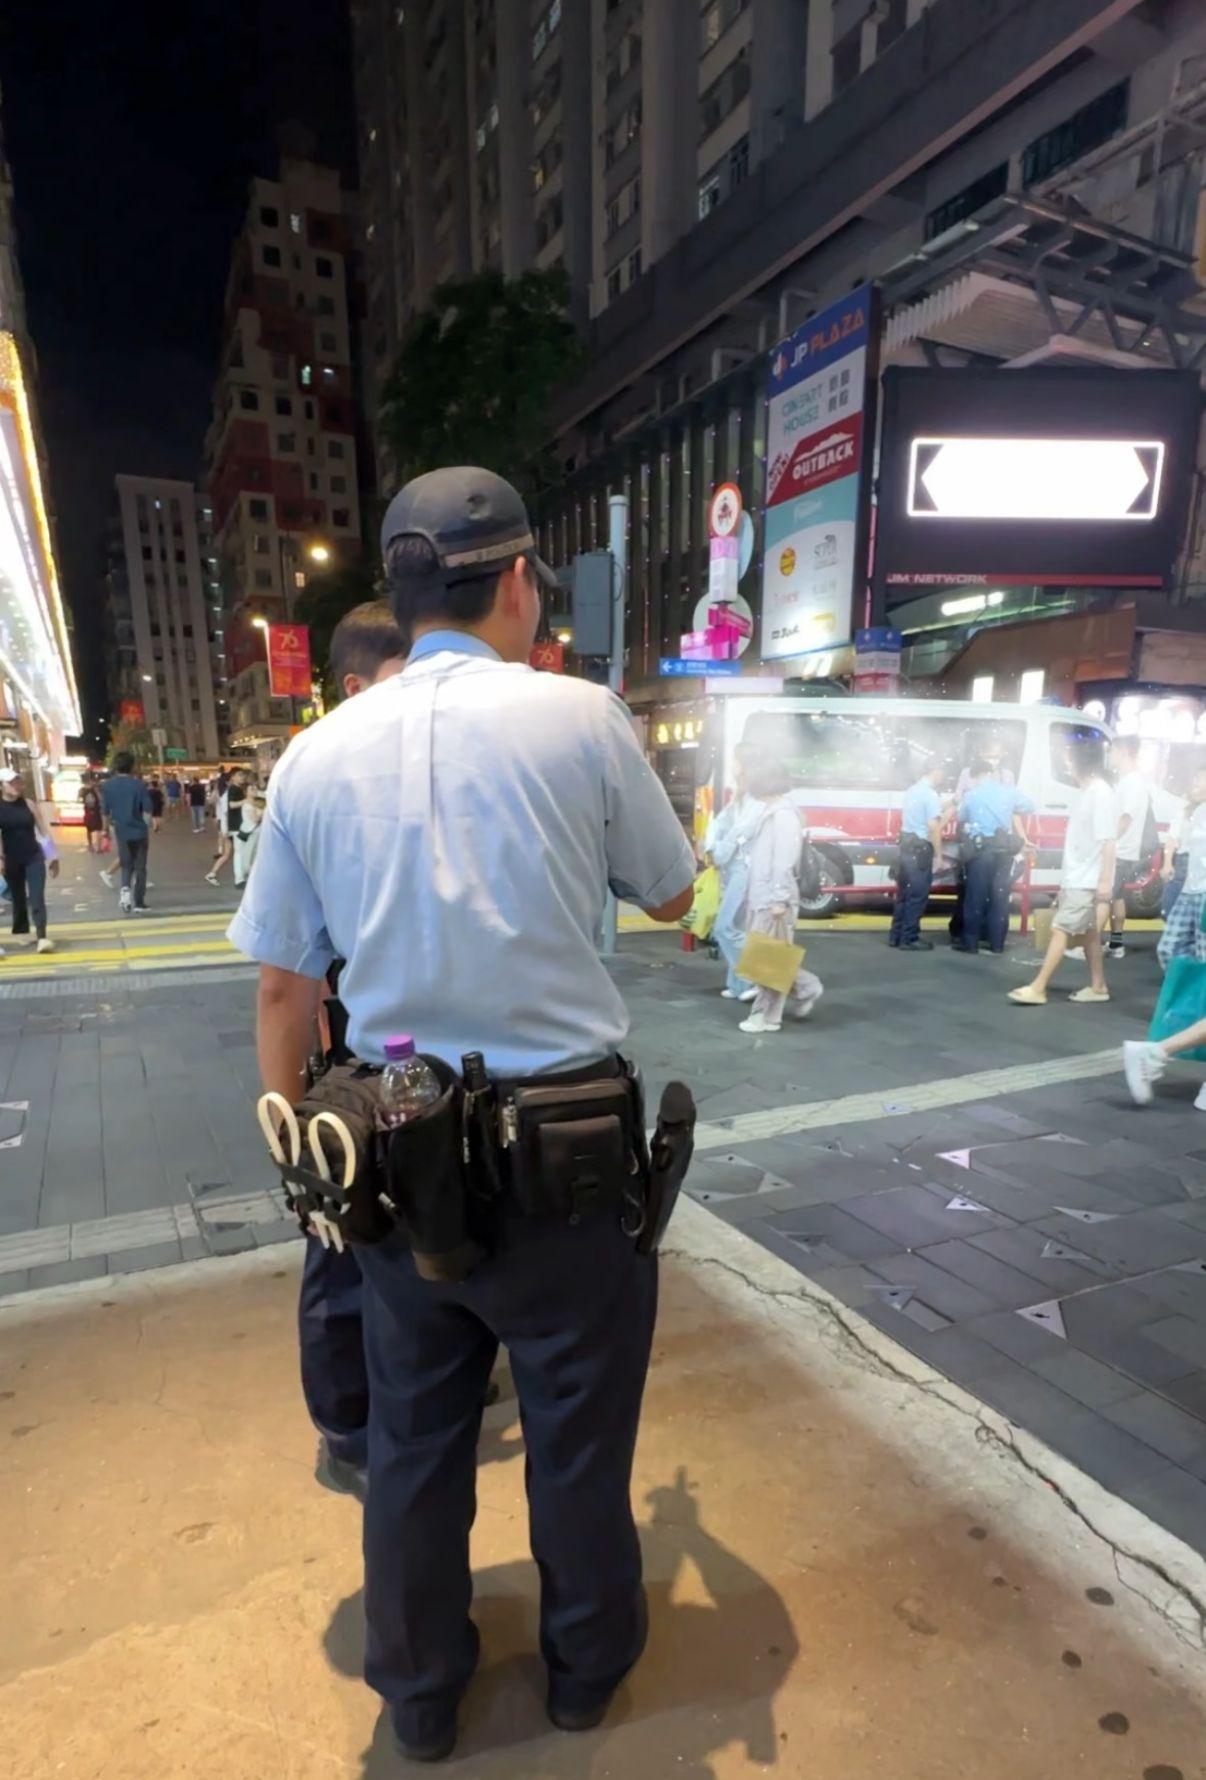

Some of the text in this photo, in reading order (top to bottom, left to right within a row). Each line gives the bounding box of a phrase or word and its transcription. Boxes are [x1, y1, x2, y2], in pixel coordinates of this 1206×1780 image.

[790, 307, 865, 368] JP PLAZA
[792, 440, 854, 480] OUTBACK
[913, 573, 988, 584] NETWORK
